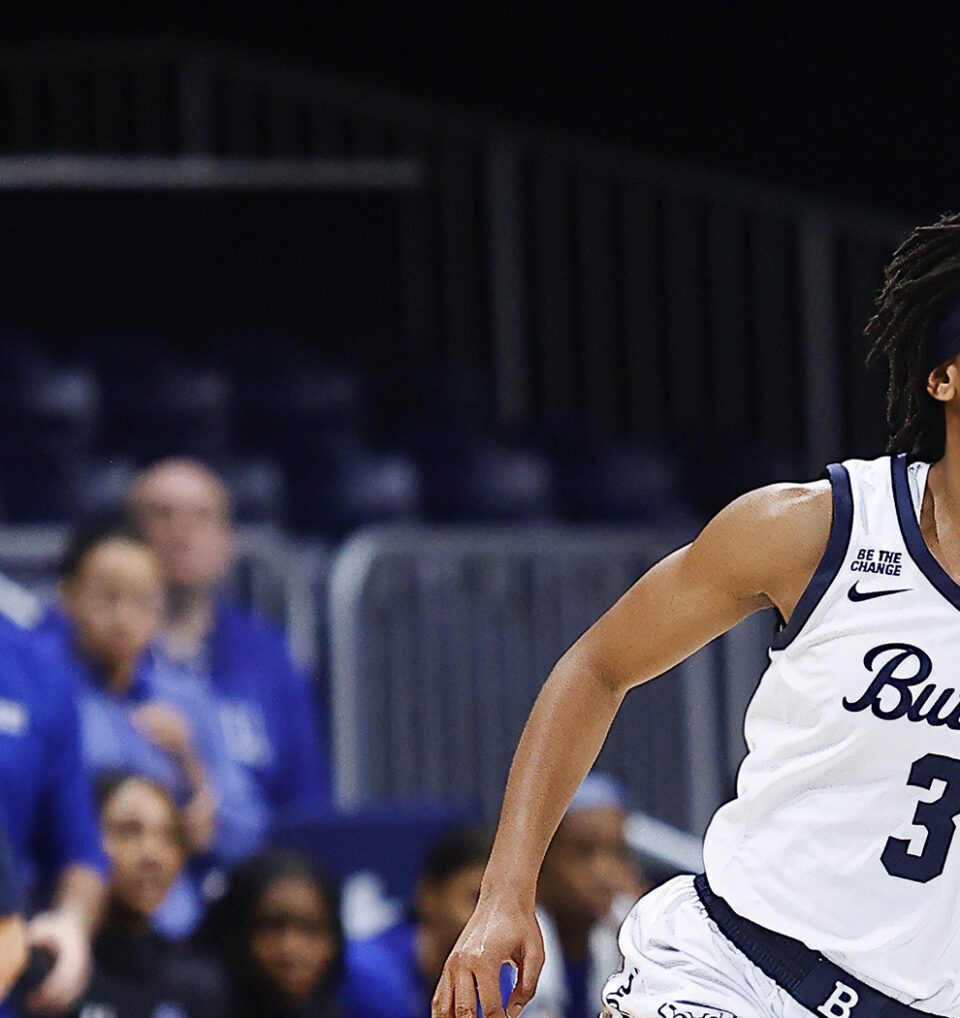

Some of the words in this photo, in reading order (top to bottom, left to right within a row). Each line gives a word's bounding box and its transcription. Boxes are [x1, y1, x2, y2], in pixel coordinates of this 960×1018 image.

[857, 548, 875, 561] BE
[878, 550, 902, 564] THE
[850, 560, 902, 577] CHANGE
